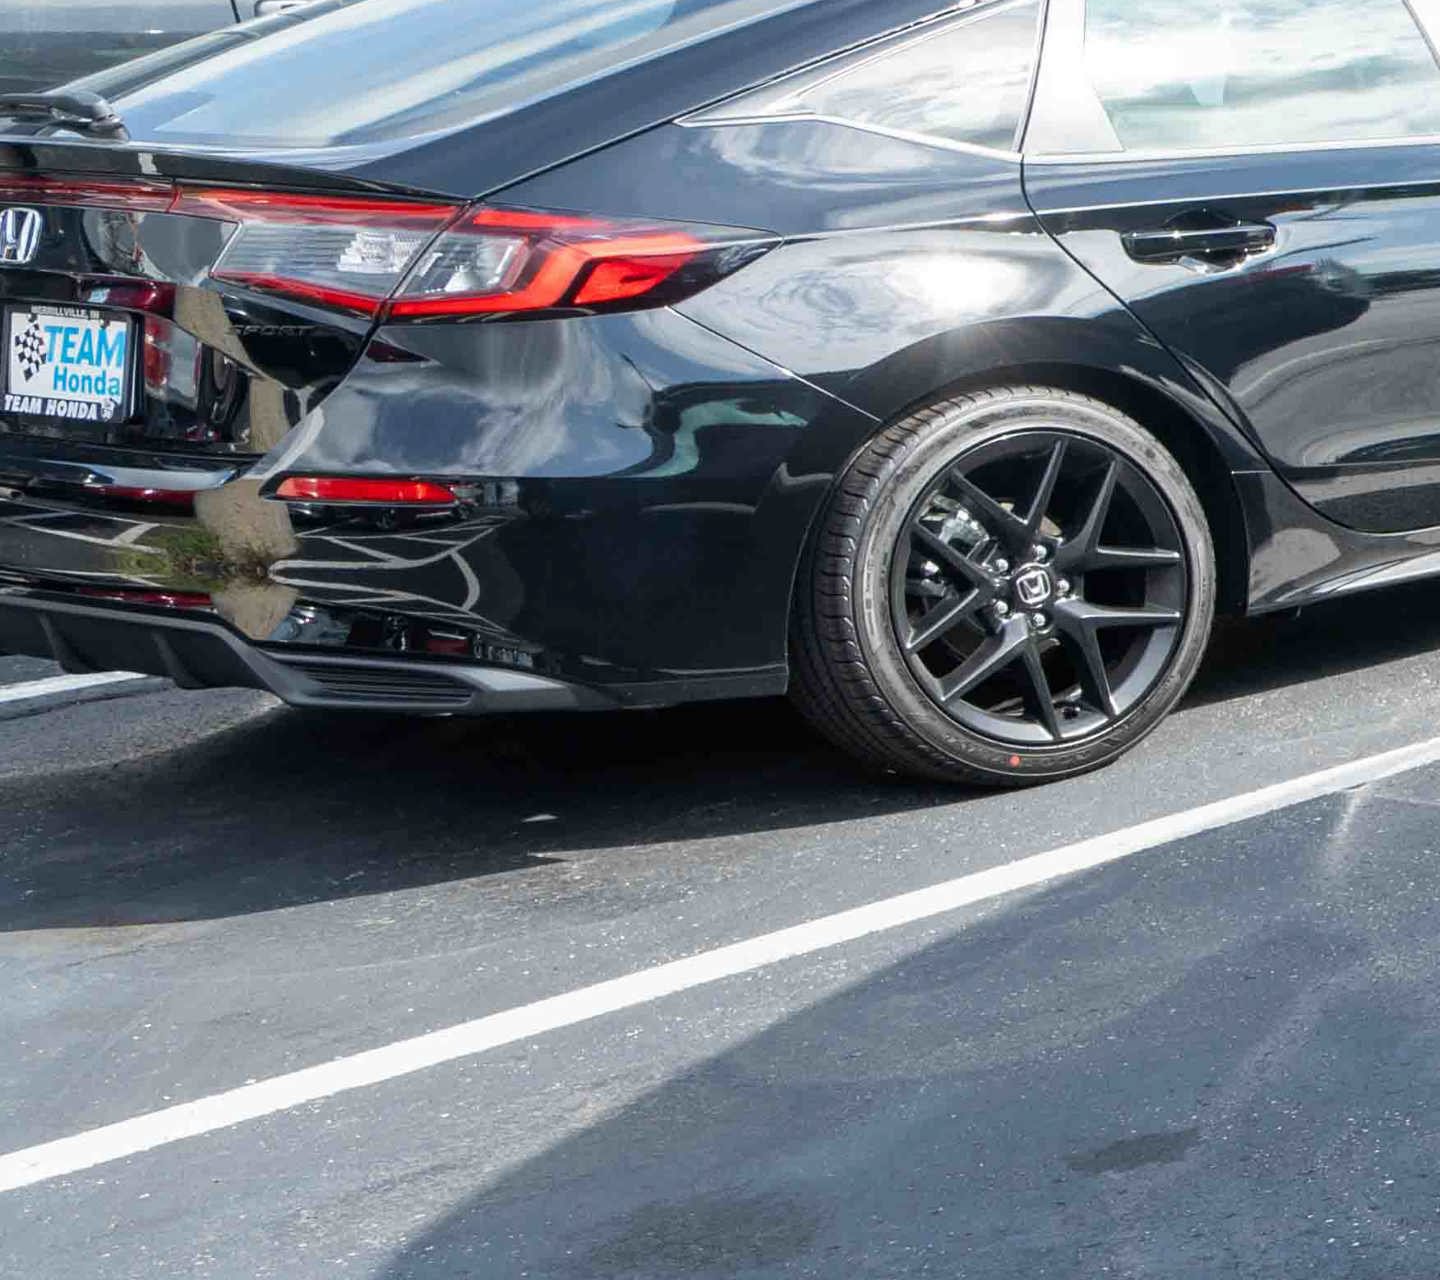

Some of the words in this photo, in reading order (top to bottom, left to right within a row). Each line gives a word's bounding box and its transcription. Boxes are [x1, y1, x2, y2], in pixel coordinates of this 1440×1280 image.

[44, 325, 126, 368] TEAM
[53, 365, 120, 396] Honda
[4, 394, 42, 415] TEAM
[45, 398, 98, 421] HONDA
